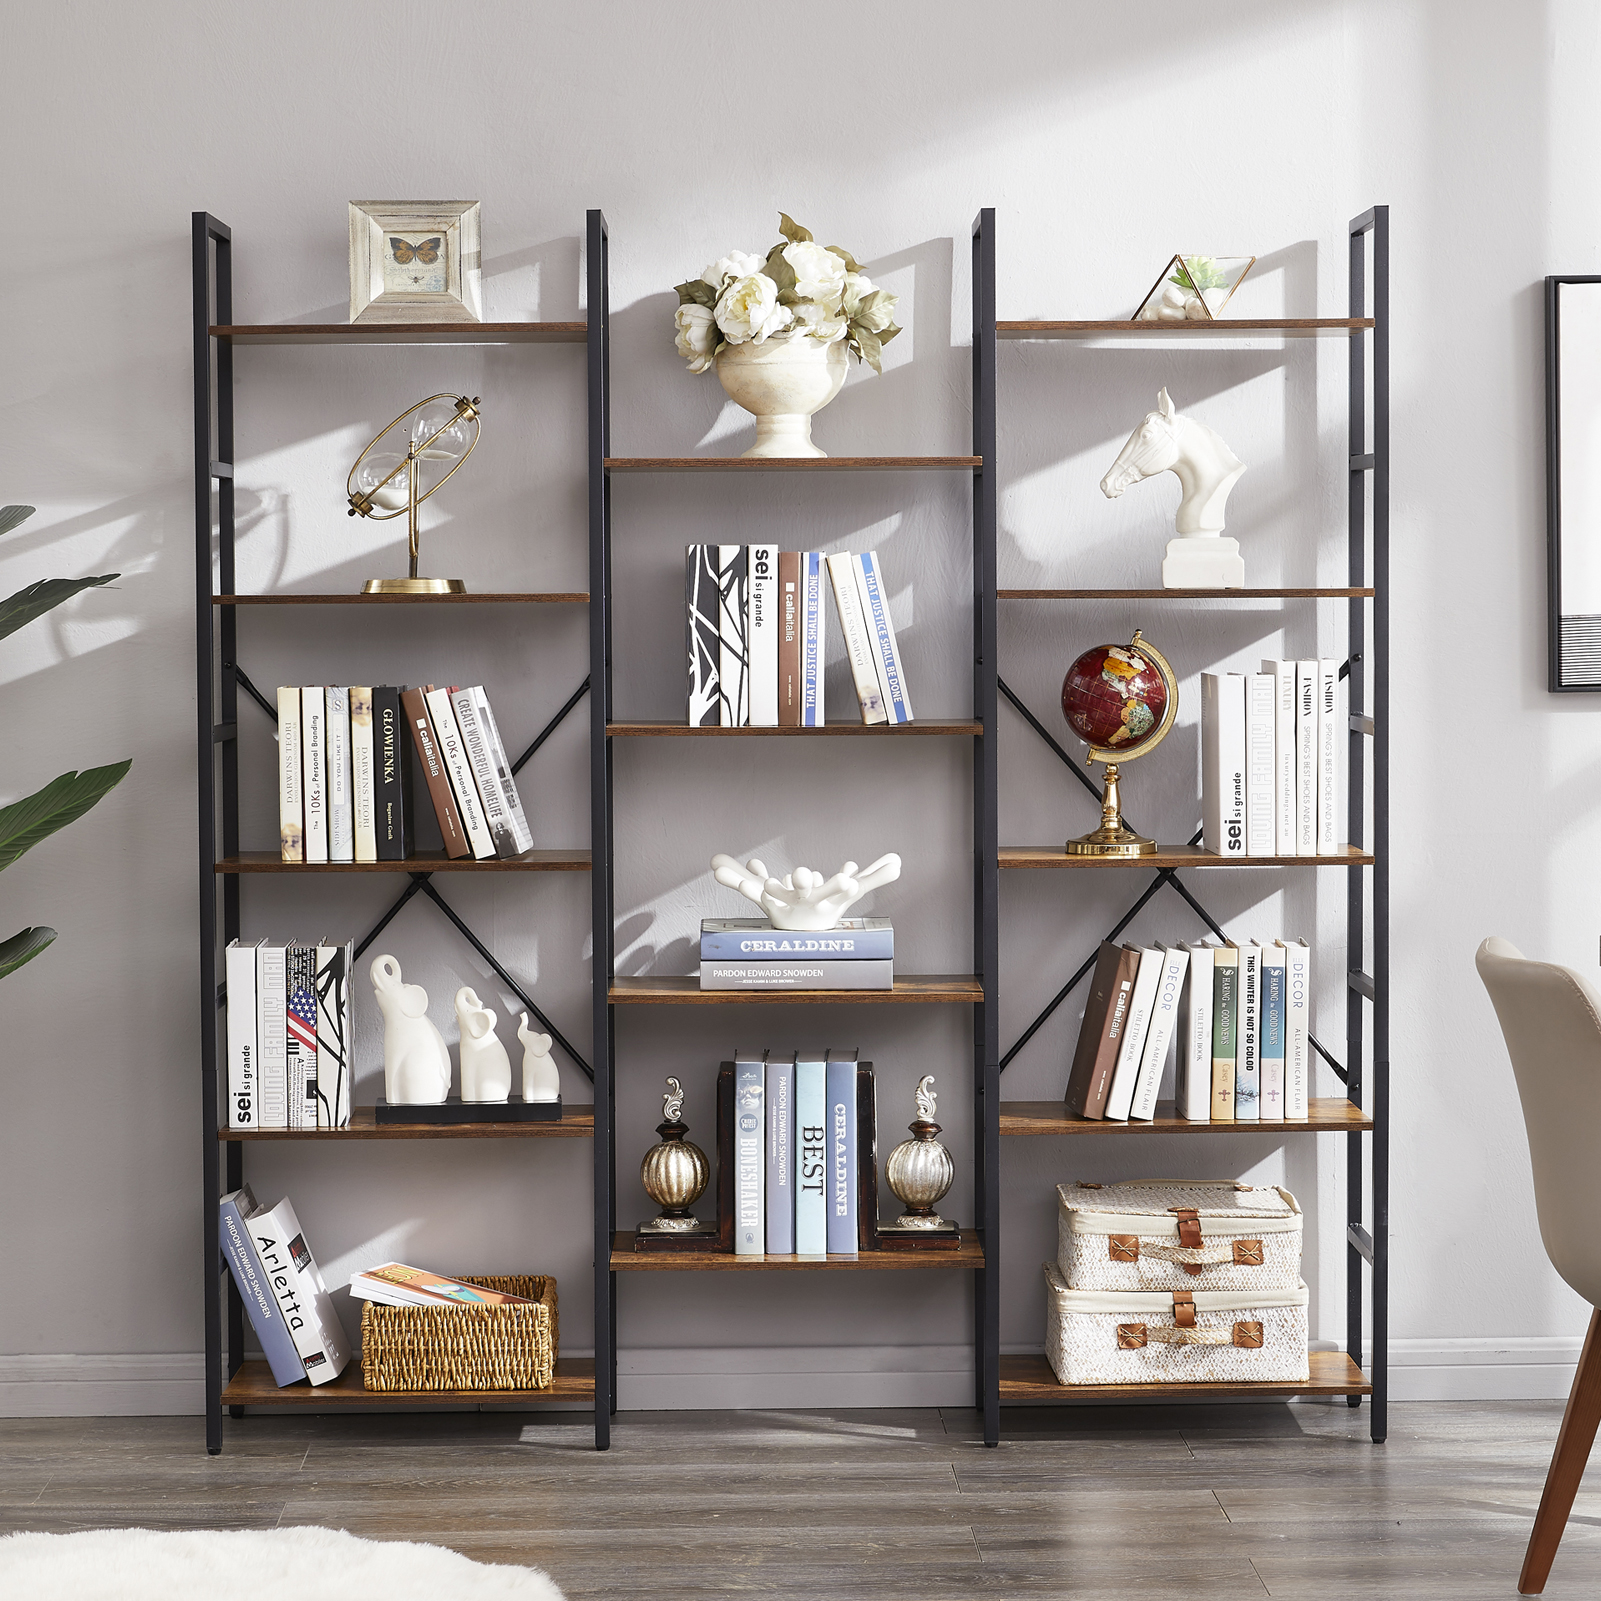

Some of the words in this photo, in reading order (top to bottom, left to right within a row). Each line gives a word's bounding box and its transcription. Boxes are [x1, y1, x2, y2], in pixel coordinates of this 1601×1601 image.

[755, 549, 772, 580] sei
[755, 582, 764, 590] si
[809, 574, 818, 598] DONE
[865, 571, 878, 596] THAT
[753, 594, 763, 628] grande
[809, 600, 818, 611] BE
[840, 586, 851, 617] TEORI
[871, 598, 887, 636] JUSTICE
[785, 594, 795, 642] caliaitalia
[808, 614, 818, 640] SHALL
[848, 618, 863, 666] DARWINS
[880, 637, 894, 666] SHALL
[807, 643, 817, 681] JUSTICE
[886, 666, 897, 678] BE
[806, 683, 816, 708] THAT
[890, 677, 903, 703] DONE
[1252, 679, 1272, 716] MAN
[1283, 676, 1291, 711] LUXURY
[1325, 675, 1333, 713] FASHION
[458, 699, 475, 728] CREATE
[420, 730, 439, 777] caliaitalia
[466, 728, 487, 778] WONDERFUL
[1252, 724, 1272, 785] FAMILY
[337, 781, 341, 791] DO
[445, 734, 459, 759] 10Ks
[455, 766, 470, 797] Personal
[465, 799, 478, 830] Branding
[1233, 772, 1243, 806] grande
[311, 790, 320, 814] 10Ks
[481, 779, 502, 819] HOMELIFE
[1233, 809, 1241, 817] si
[1224, 820, 1241, 850] sei
[1251, 793, 1272, 848] LOVING
[263, 952, 284, 989] MAN
[1293, 964, 1304, 1008] DECOR
[1161, 965, 1180, 1011] DECOR
[263, 997, 284, 1058] FAMILY
[1109, 992, 1126, 1038] caliaitalia
[1221, 1010, 1229, 1027] GOOD
[1270, 1010, 1278, 1027] GOOD
[1126, 1042, 1136, 1062] BOOK
[1221, 1028, 1229, 1045] NEWS
[1246, 1033, 1254, 1044] SO
[1270, 1028, 1278, 1045] NEWS
[242, 1045, 252, 1078] grande
[1146, 1029, 1163, 1086] ALL-AMERICAN
[1220, 1064, 1230, 1082] Casey
[1246, 1046, 1254, 1071] COLOD
[1269, 1064, 1279, 1082] Casey
[242, 1082, 250, 1090] si
[264, 1066, 285, 1121] LOVING
[1142, 1088, 1152, 1110] FLAIR
[234, 1092, 251, 1123] sei
[802, 1126, 824, 1196] BEST
[740, 1138, 758, 1227] BONESHAKER
[224, 1215, 242, 1248] PARDON
[237, 1245, 256, 1280] EDWARD
[251, 1280, 271, 1318] SNOWDEN
[257, 1237, 304, 1331] Arletta
